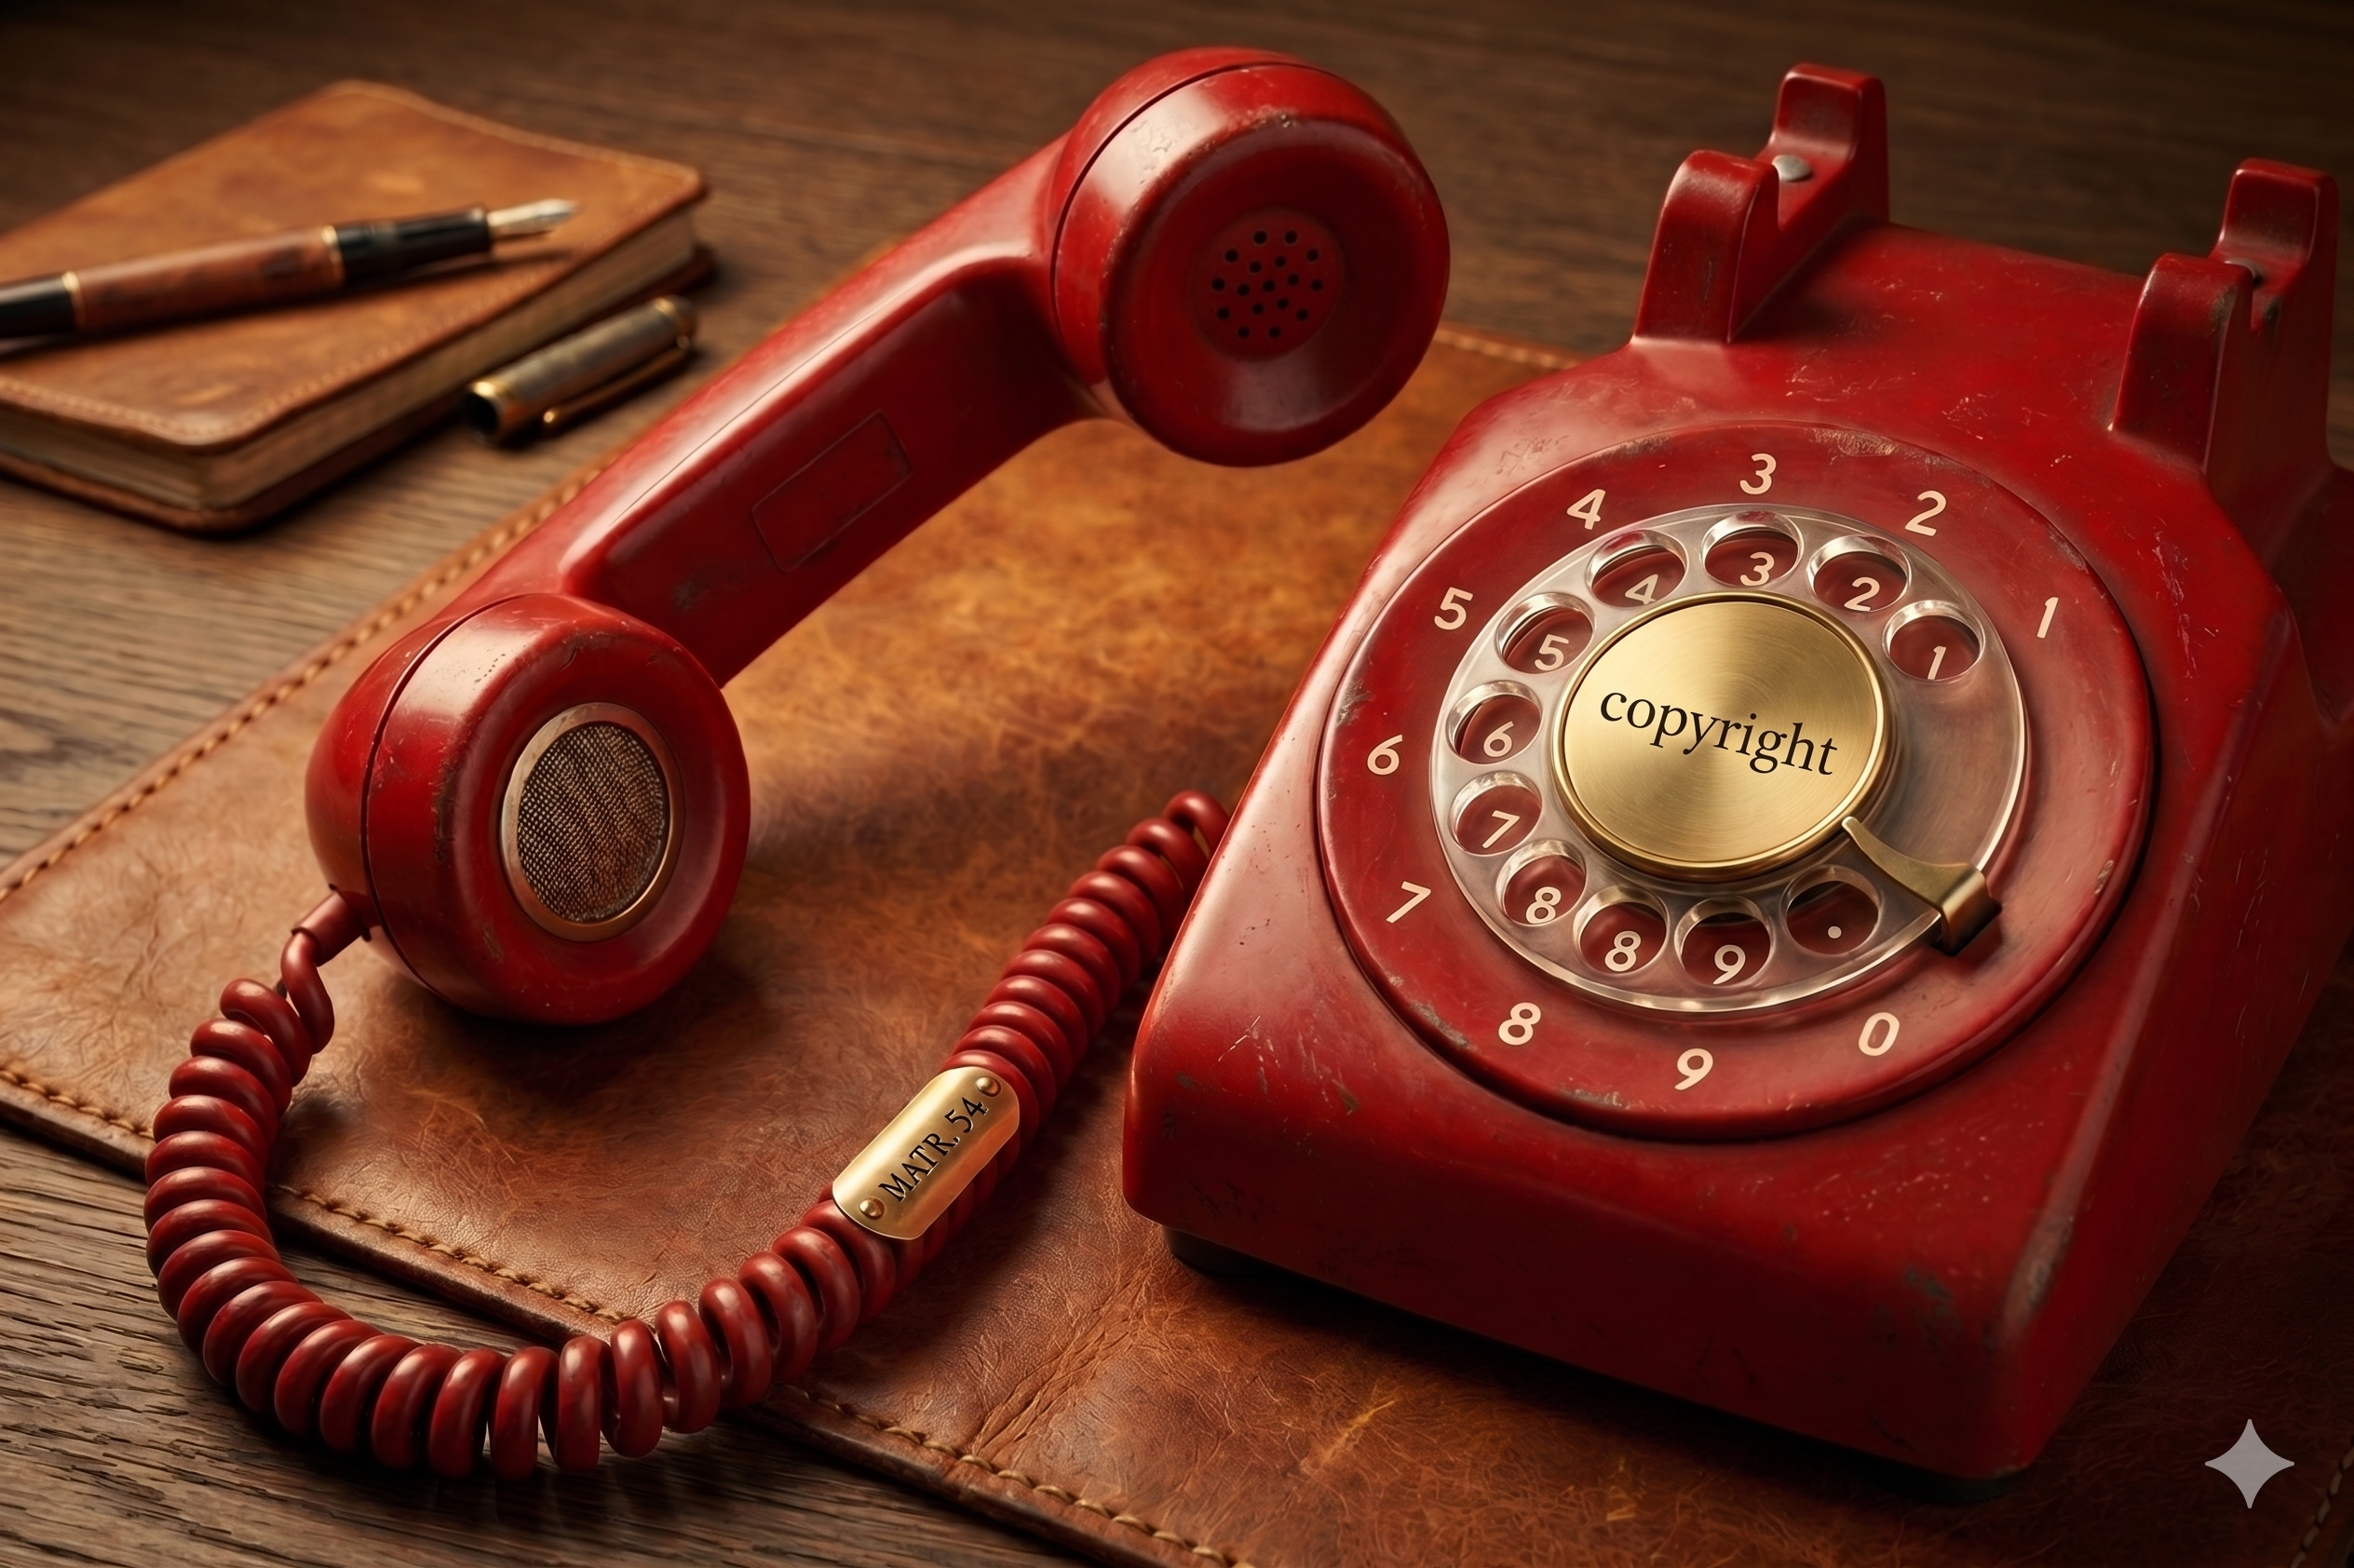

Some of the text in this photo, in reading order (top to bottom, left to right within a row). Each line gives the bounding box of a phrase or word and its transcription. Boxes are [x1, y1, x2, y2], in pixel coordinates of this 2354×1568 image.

[1739, 453, 1777, 495] 3
[1567, 489, 1606, 531] 4
[1905, 490, 1947, 537] 2
[1625, 574, 1660, 605] 4
[1739, 551, 1776, 587] 3
[1434, 587, 1474, 630] 5
[1844, 576, 1881, 612] 2
[2036, 597, 2059, 639] 1
[1534, 634, 1569, 671] 5
[1927, 645, 1947, 681] 1
[1483, 721, 1515, 758] 6
[1599, 690, 1838, 776] copyright
[1367, 734, 1403, 776] 6
[1481, 809, 1521, 849] 7
[1386, 881, 1432, 924] 7
[1525, 885, 1562, 925] 8
[1604, 930, 1642, 972] 8
[1712, 944, 1746, 985] 9
[1497, 1002, 1542, 1046] 8
[1858, 1012, 1901, 1057] 0
[1675, 1048, 1713, 1090] 9
[878, 1132, 959, 1202] MATR.
